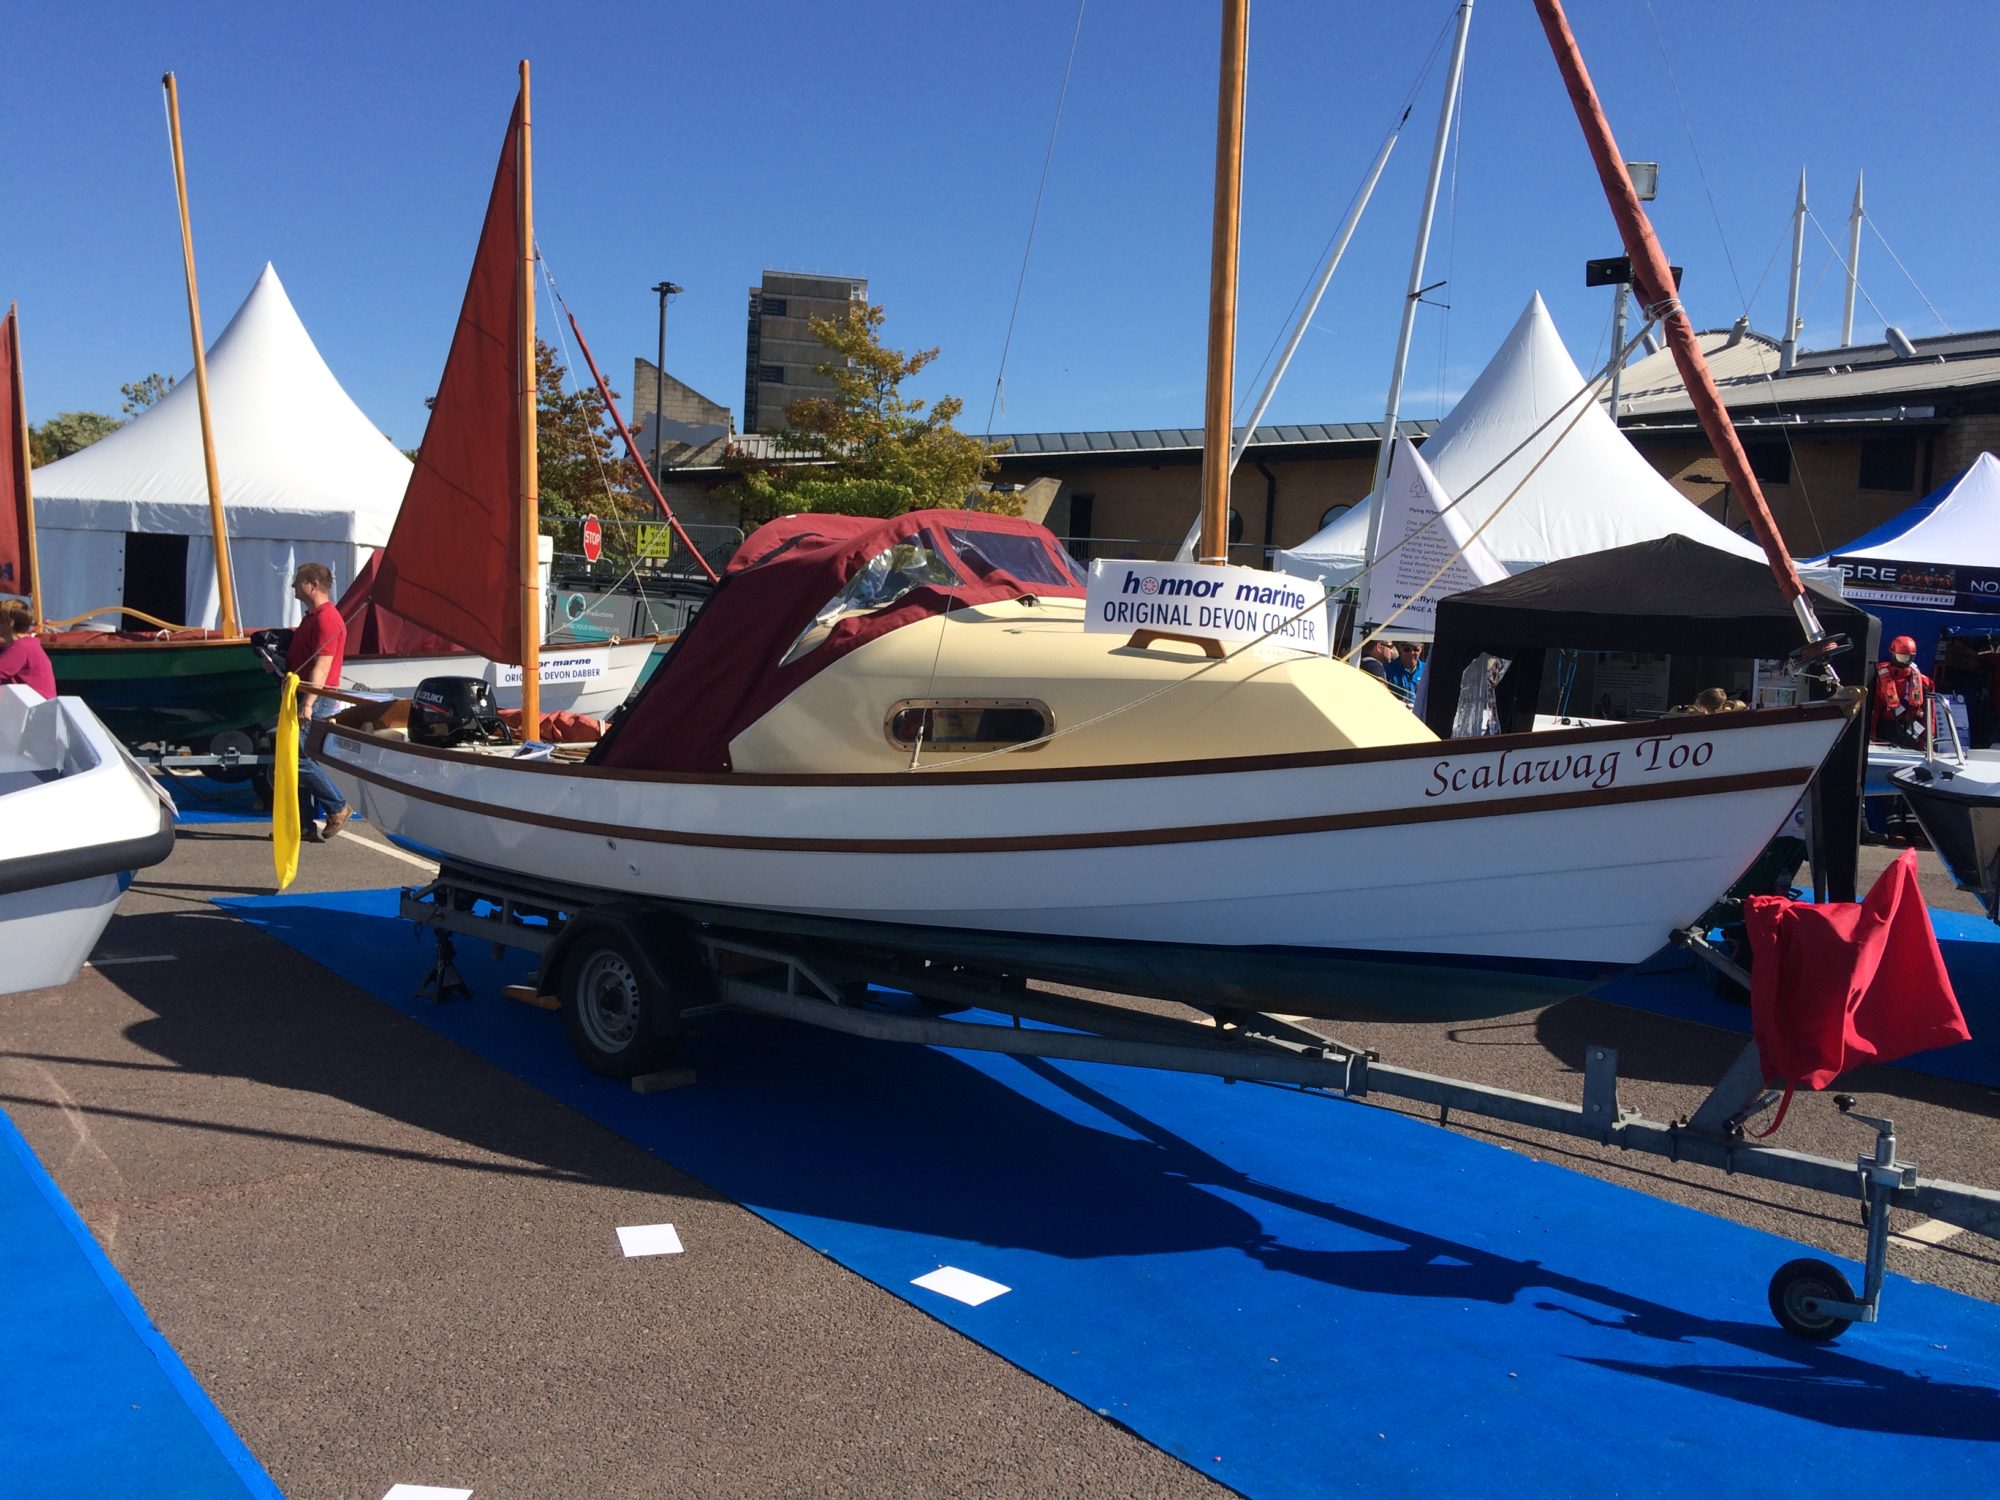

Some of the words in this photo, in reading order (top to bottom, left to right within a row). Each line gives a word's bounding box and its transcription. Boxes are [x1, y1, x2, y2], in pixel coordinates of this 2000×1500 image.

[585, 530, 600, 546] STOP
[1121, 570, 1224, 599] honnor
[1236, 583, 1306, 610] marine
[1971, 580, 2000, 593] NO
[1392, 602, 1426, 613] ARANGE
[1103, 601, 1193, 627] ORIGINAL
[1199, 606, 1258, 632] DEVON
[1262, 613, 1315, 641] COASTER
[552, 658, 592, 667] marine
[544, 670, 571, 680] DEVON
[572, 668, 600, 678] DABBER
[1424, 749, 1621, 797] Scalawag
[1636, 734, 1714, 772] Too
